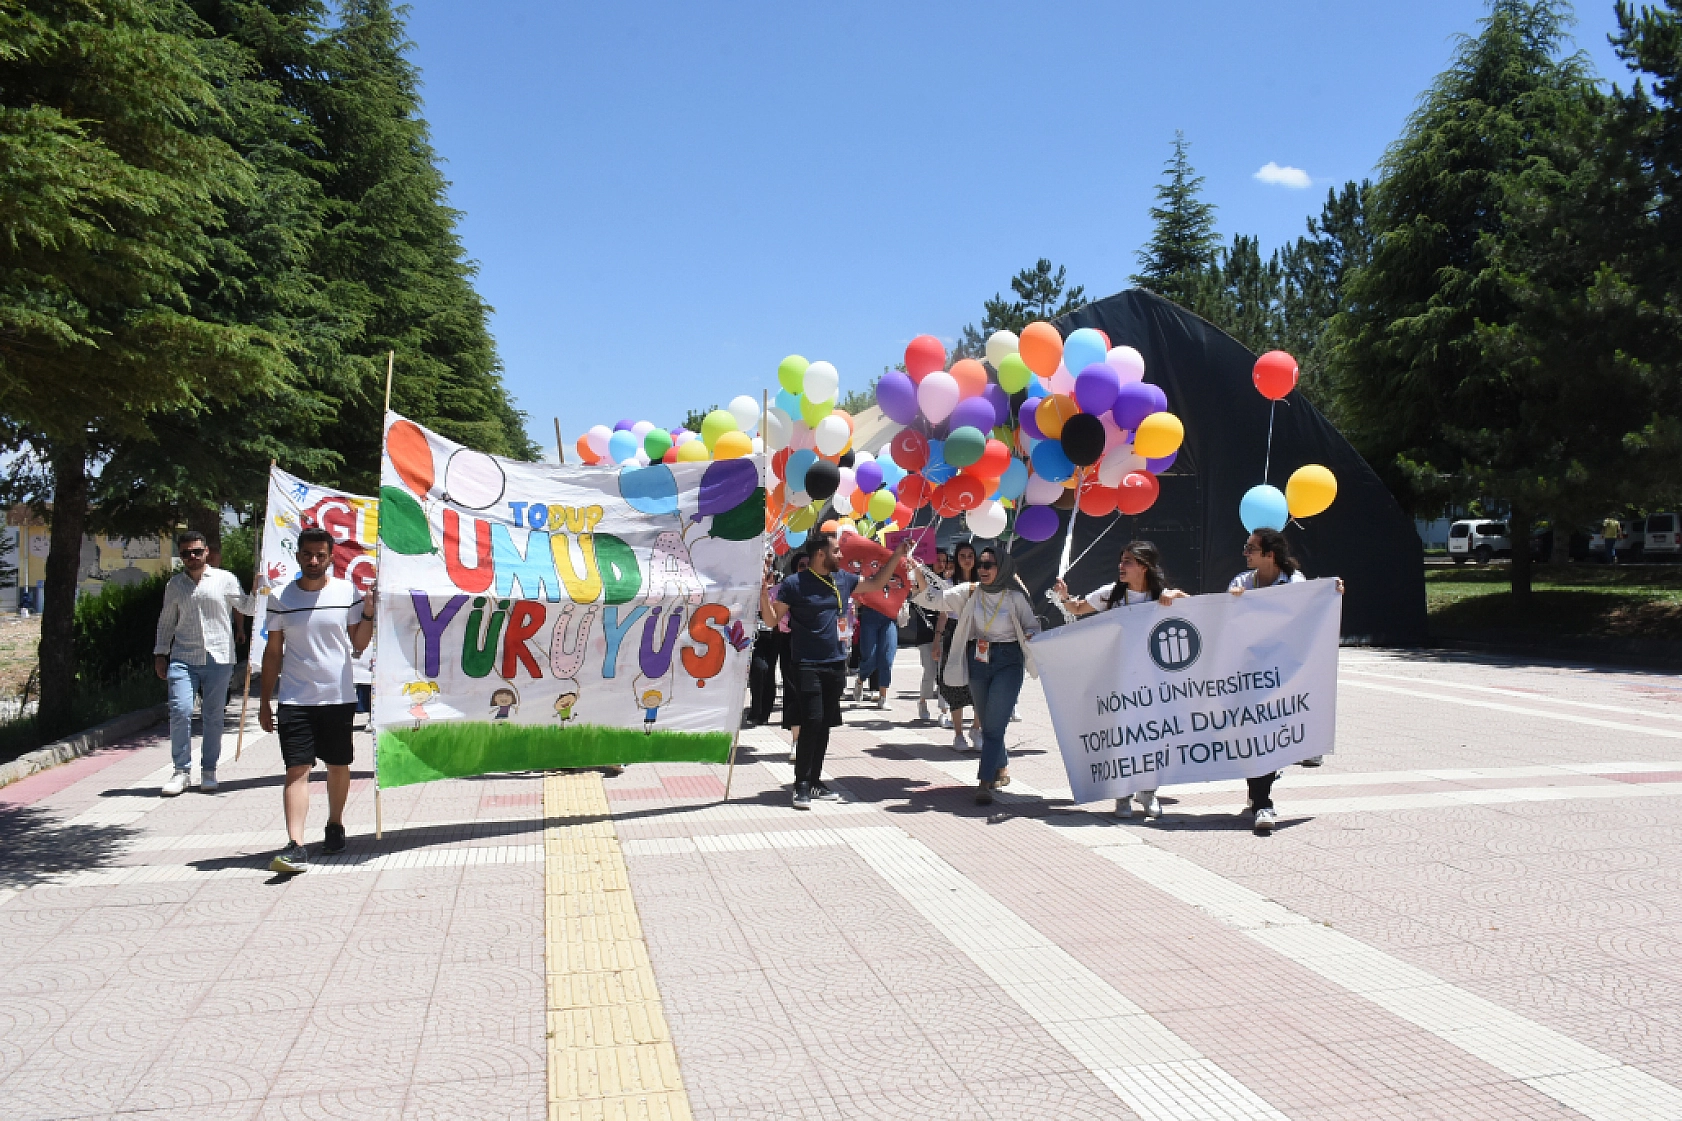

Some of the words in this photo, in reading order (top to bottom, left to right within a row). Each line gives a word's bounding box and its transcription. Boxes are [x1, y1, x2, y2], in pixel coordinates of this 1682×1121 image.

[442, 508, 705, 605] UMUDA
[409, 589, 731, 688] YÜRÜYÜŞ
[1096, 685, 1153, 716] İNÖNÜ
[1159, 666, 1281, 703] ÜNİVERSİTESİ
[1079, 716, 1184, 754] TOPLUMSAL
[1190, 692, 1310, 732] DUYARLILIK
[1090, 743, 1170, 783] PROJELERİ
[1177, 723, 1305, 765] TOPLULUĞU
